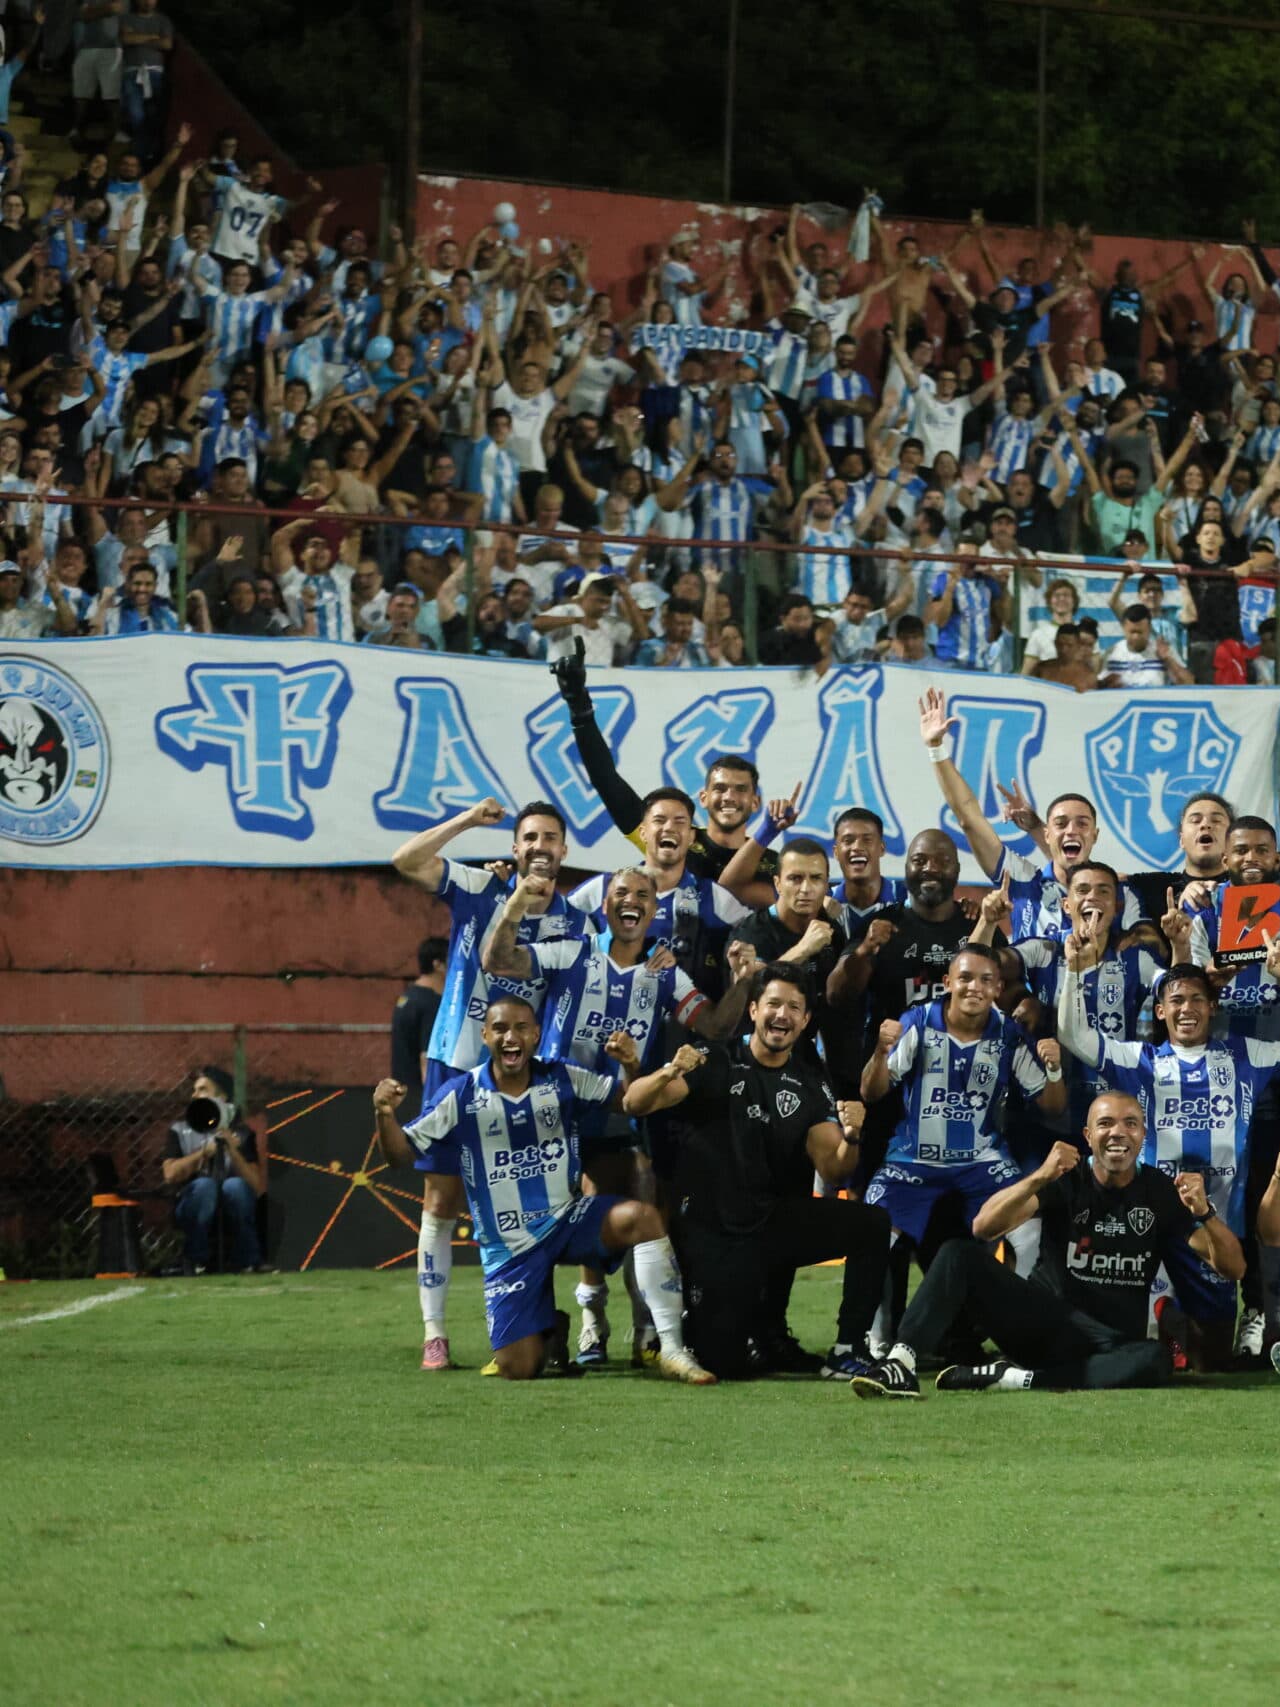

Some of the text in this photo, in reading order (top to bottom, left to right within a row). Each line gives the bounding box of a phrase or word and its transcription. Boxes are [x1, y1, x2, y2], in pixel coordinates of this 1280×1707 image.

[230, 206, 263, 238] 07
[1164, 1097, 1208, 1115] Bet
[1176, 1116, 1226, 1129] Sorte
[494, 1147, 539, 1168] Bet
[508, 1163, 558, 1181] Sorte
